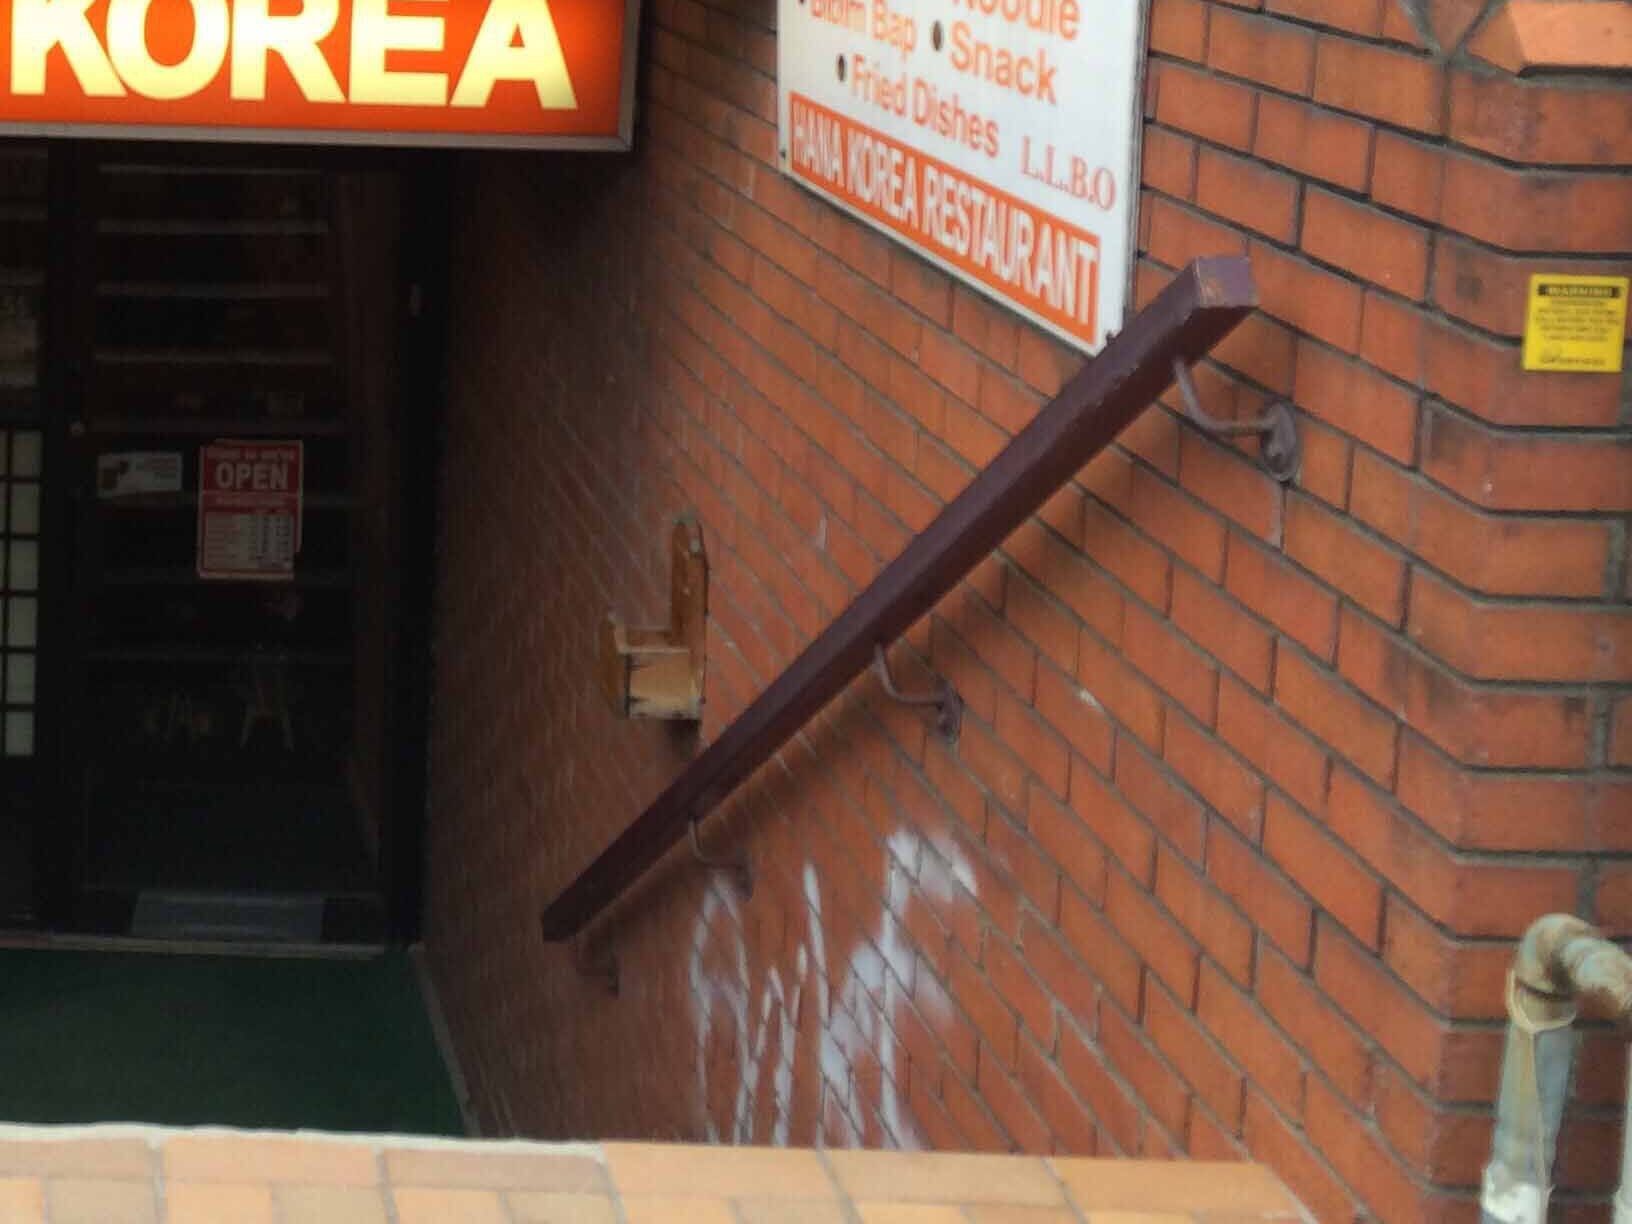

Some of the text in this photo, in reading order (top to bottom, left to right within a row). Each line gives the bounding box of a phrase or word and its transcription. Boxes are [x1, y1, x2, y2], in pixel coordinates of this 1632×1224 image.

[850, 54, 999, 158] Fried Dishes
[950, 21, 1058, 105] Snack
[793, 101, 1098, 327] HANA KOREA RESTAURANT
[216, 462, 289, 489] OPEN
